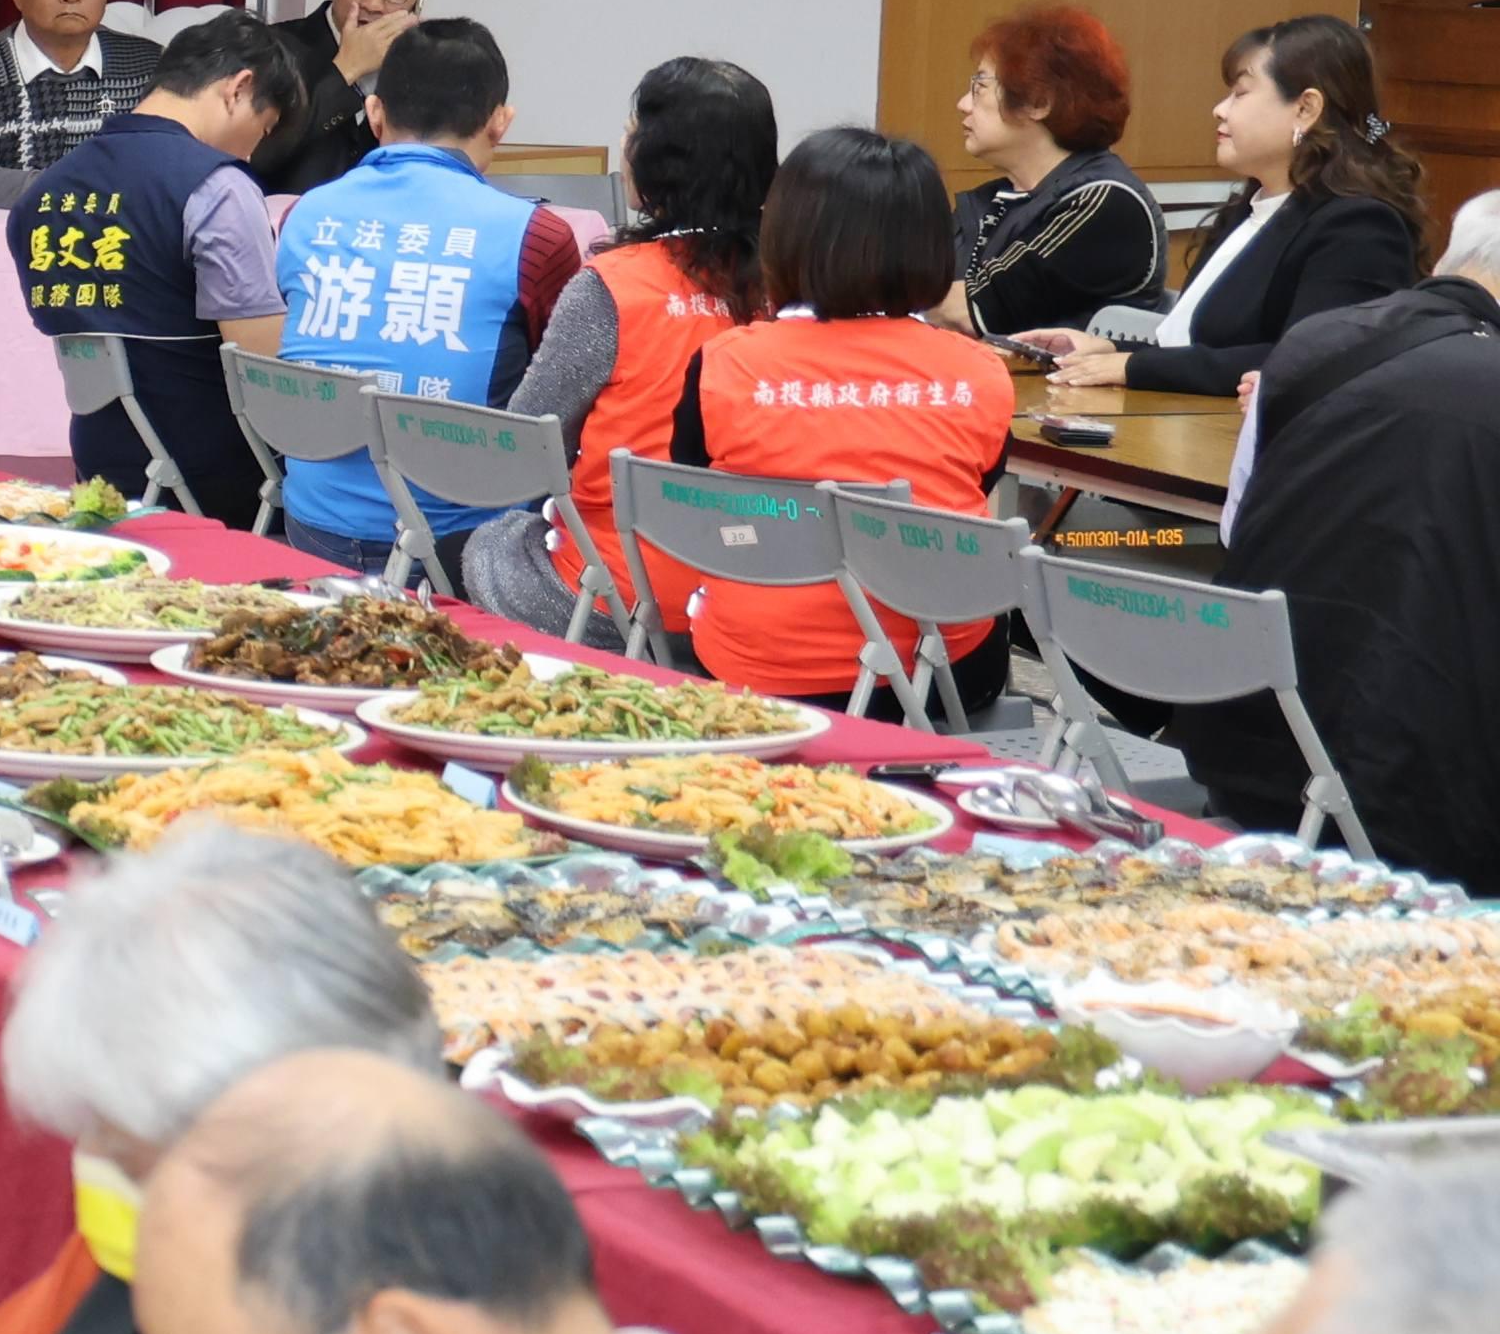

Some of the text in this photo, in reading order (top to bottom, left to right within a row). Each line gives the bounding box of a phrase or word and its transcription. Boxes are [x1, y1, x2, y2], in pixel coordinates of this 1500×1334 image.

[37, 192, 123, 216] 立法委員
[29, 224, 131, 273] 馬文君
[311, 216, 477, 259] 立法委員
[30, 283, 125, 310] 服務團隊
[752, 379, 974, 409] 南投縣政府衛生局
